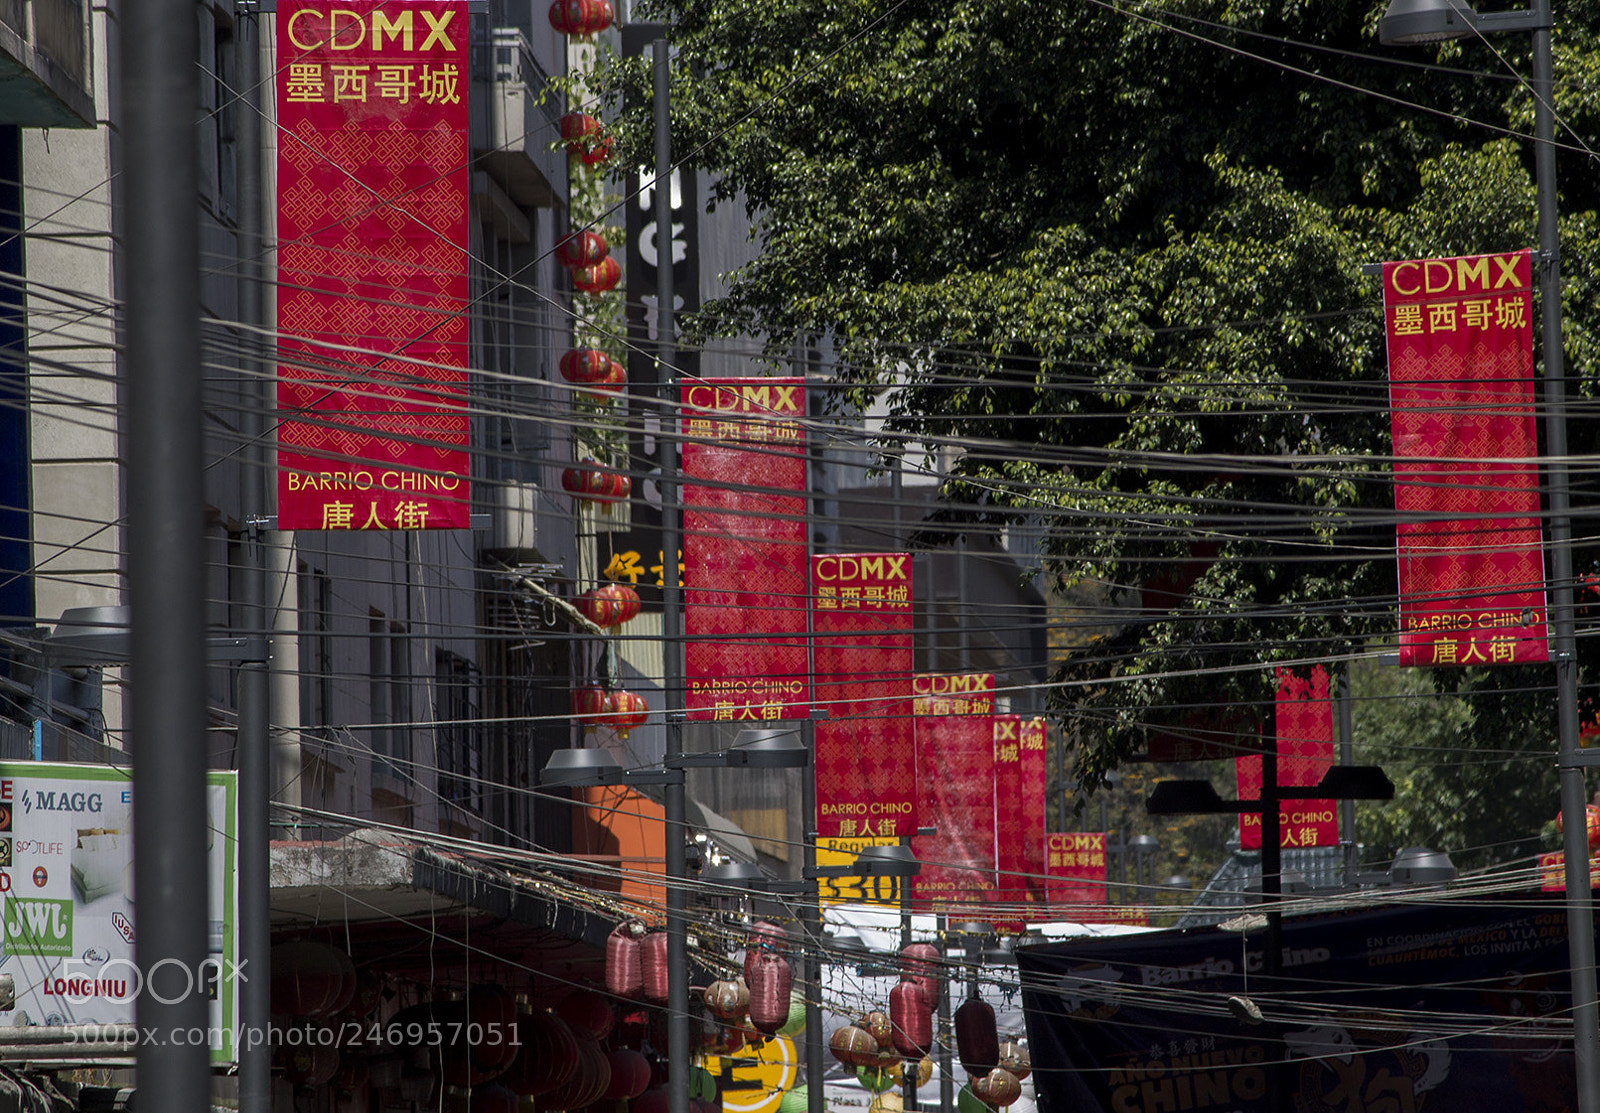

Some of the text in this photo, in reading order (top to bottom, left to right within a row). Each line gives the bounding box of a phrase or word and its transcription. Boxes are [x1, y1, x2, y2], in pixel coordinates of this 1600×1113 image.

[287, 9, 456, 51] CDMX
[286, 63, 460, 104] 墨西哥城
[1392, 255, 1522, 296] CDMX
[1393, 297, 1526, 336] 墨西哥城
[688, 386, 797, 411] CDMX
[288, 471, 459, 491] BARRIO CHINO
[321, 500, 428, 529] 唐人街
[816, 556, 906, 581] CDMX
[817, 585, 909, 608] 墨西哥城
[1408, 614, 1472, 633] BARRIO
[1432, 636, 1517, 664] 唐人街
[692, 680, 803, 694] BARRIO CHINO
[914, 674, 989, 694] CDMX
[36, 791, 102, 812] MAGG
[821, 802, 912, 814] BARRIO CHINO
[839, 819, 897, 837] 唐人街
[1244, 811, 1333, 826] BAO CHINO
[1049, 836, 1102, 850] CDMX
[1281, 828, 1318, 847] 人街
[916, 883, 955, 893] BARRIO
[114, 914, 136, 941] IUSA
[1464, 943, 1488, 956] LOS
[1490, 940, 1530, 955] INVITA
[1140, 947, 1331, 986] Barrio Cino
[44, 978, 126, 998] LONGNIU
[1171, 1045, 1265, 1076] NUEVO
[1111, 1066, 1267, 1113] CHINO
